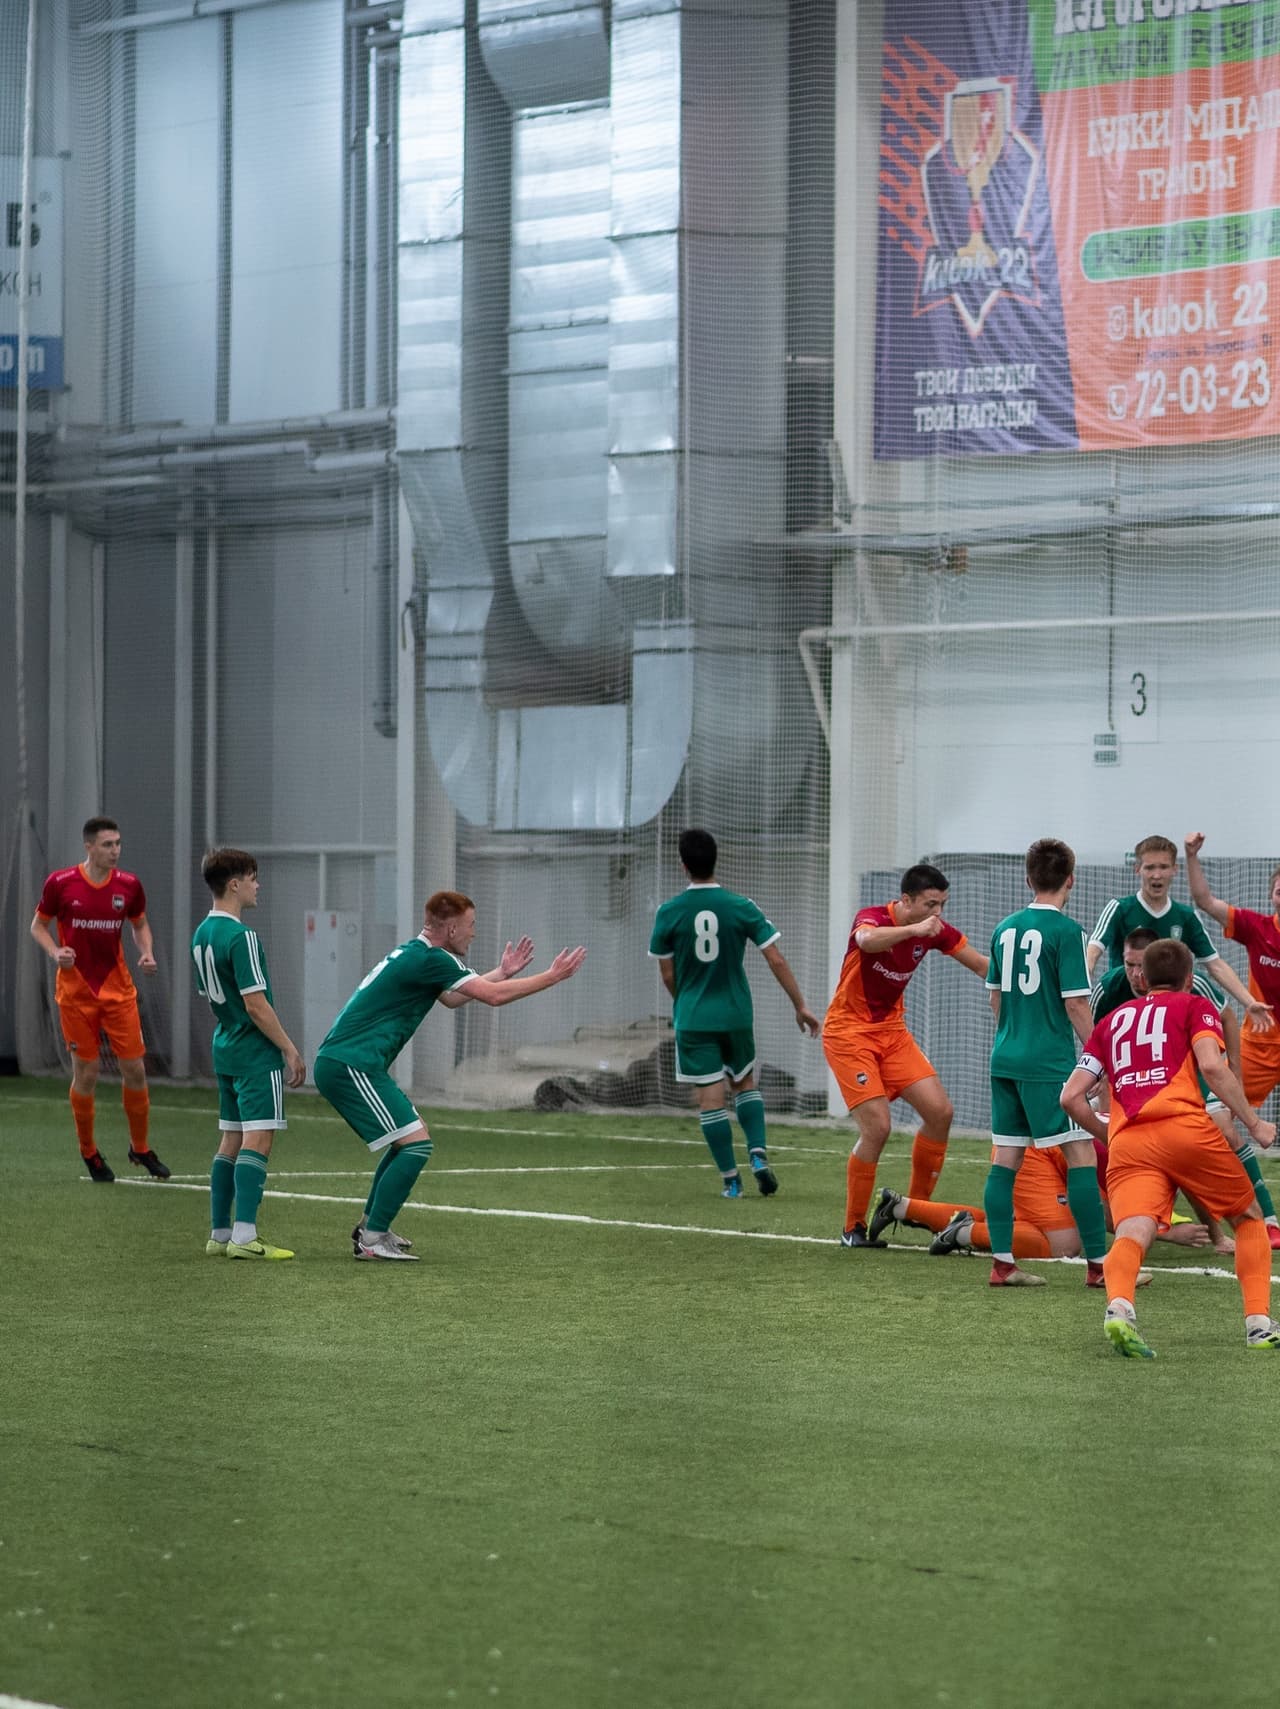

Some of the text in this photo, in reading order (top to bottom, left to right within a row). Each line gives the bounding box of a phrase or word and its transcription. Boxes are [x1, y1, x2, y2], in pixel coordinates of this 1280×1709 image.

[1133, 281, 1269, 340] kubok_22
[1135, 357, 1271, 419] 72-03-23
[1130, 671, 1147, 716] 3
[694, 909, 719, 962] 8
[999, 927, 1043, 995] 13
[193, 944, 226, 1005] 10
[1110, 1004, 1168, 1074] 24
